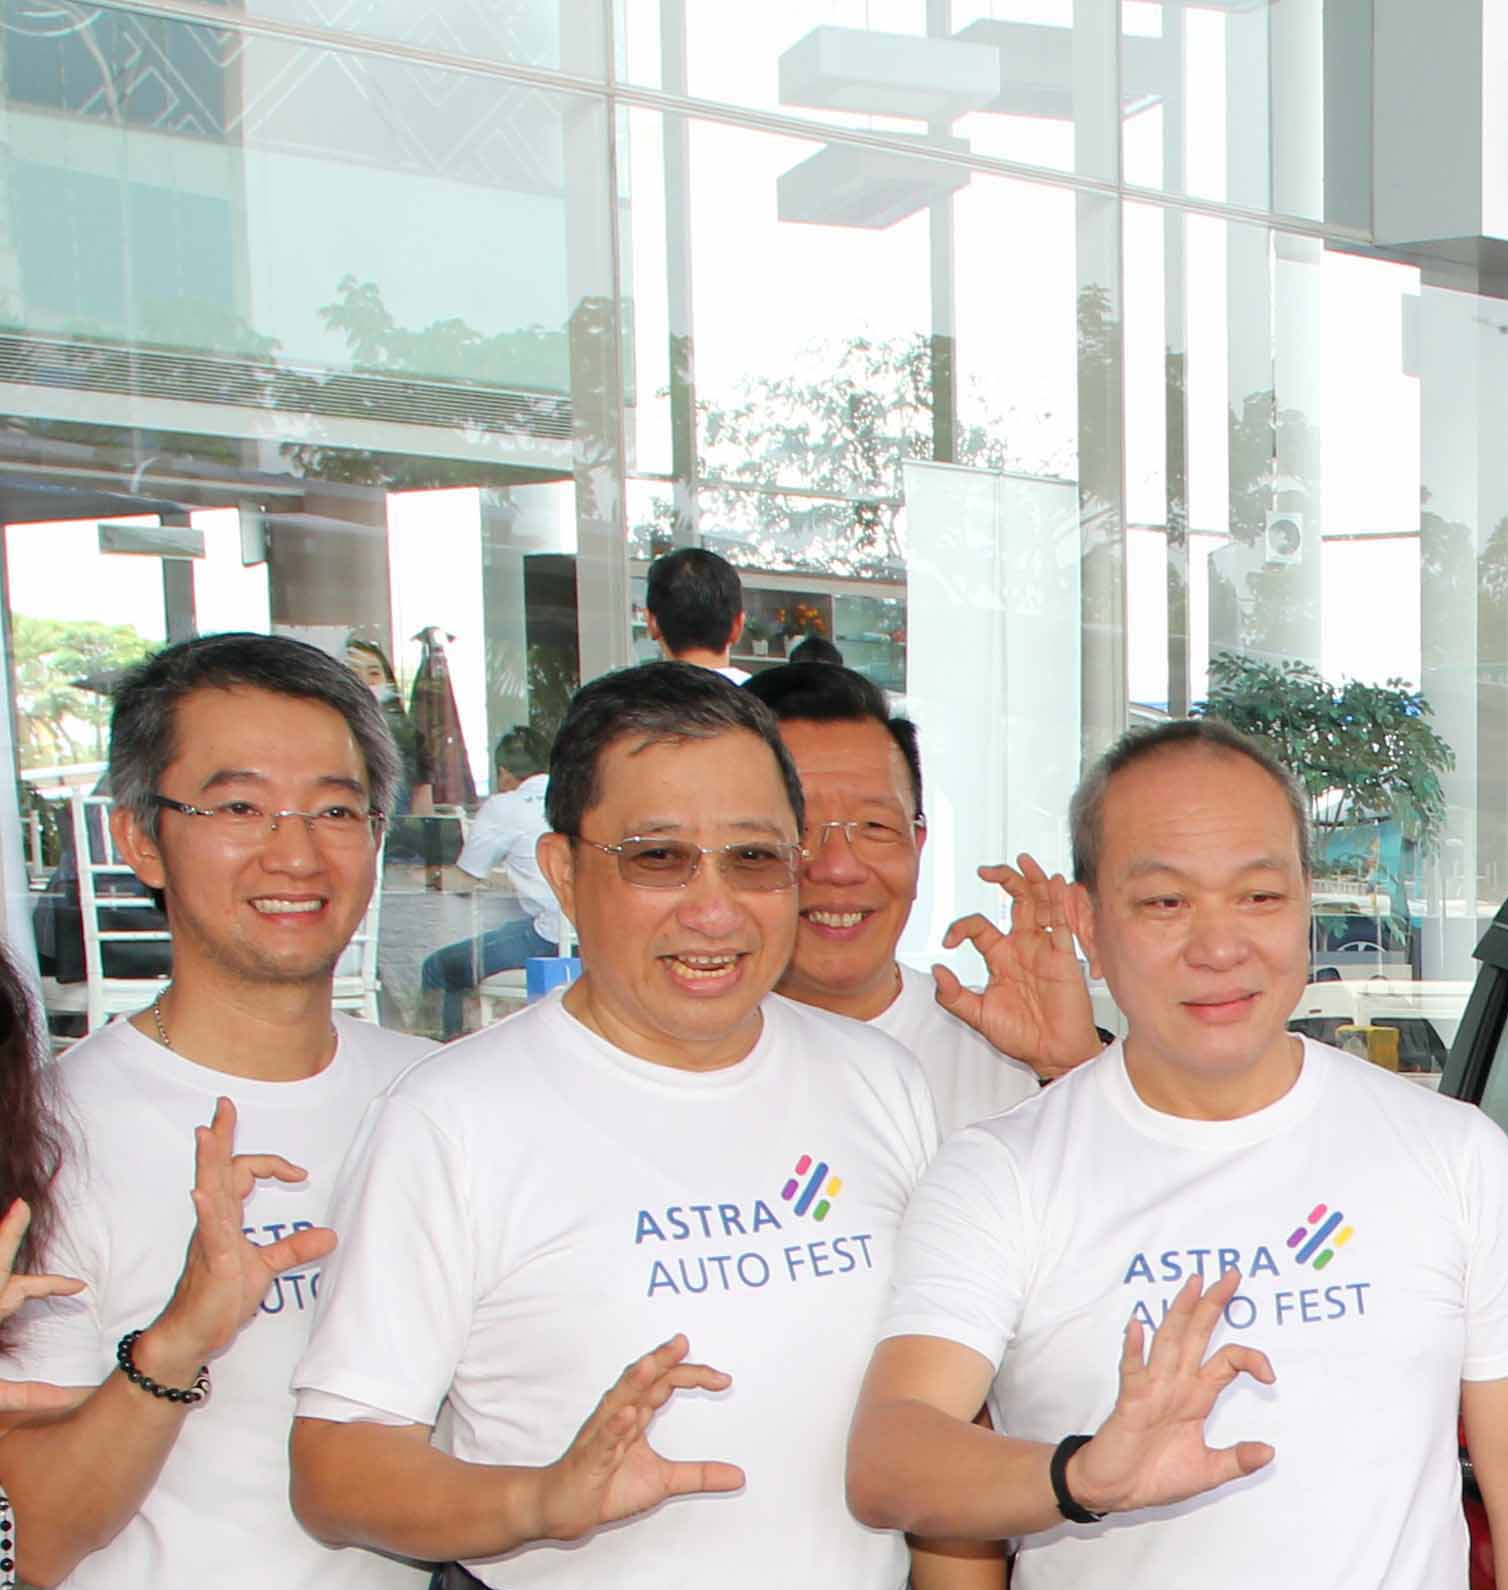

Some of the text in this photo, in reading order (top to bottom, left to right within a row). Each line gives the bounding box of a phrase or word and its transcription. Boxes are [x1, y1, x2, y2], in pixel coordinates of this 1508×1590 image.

[634, 1199, 782, 1244] ASTRA
[646, 1234, 874, 1297] AUTO FEST
[1122, 1246, 1280, 1285] ASTRA
[1123, 1282, 1370, 1335] AO FEST
